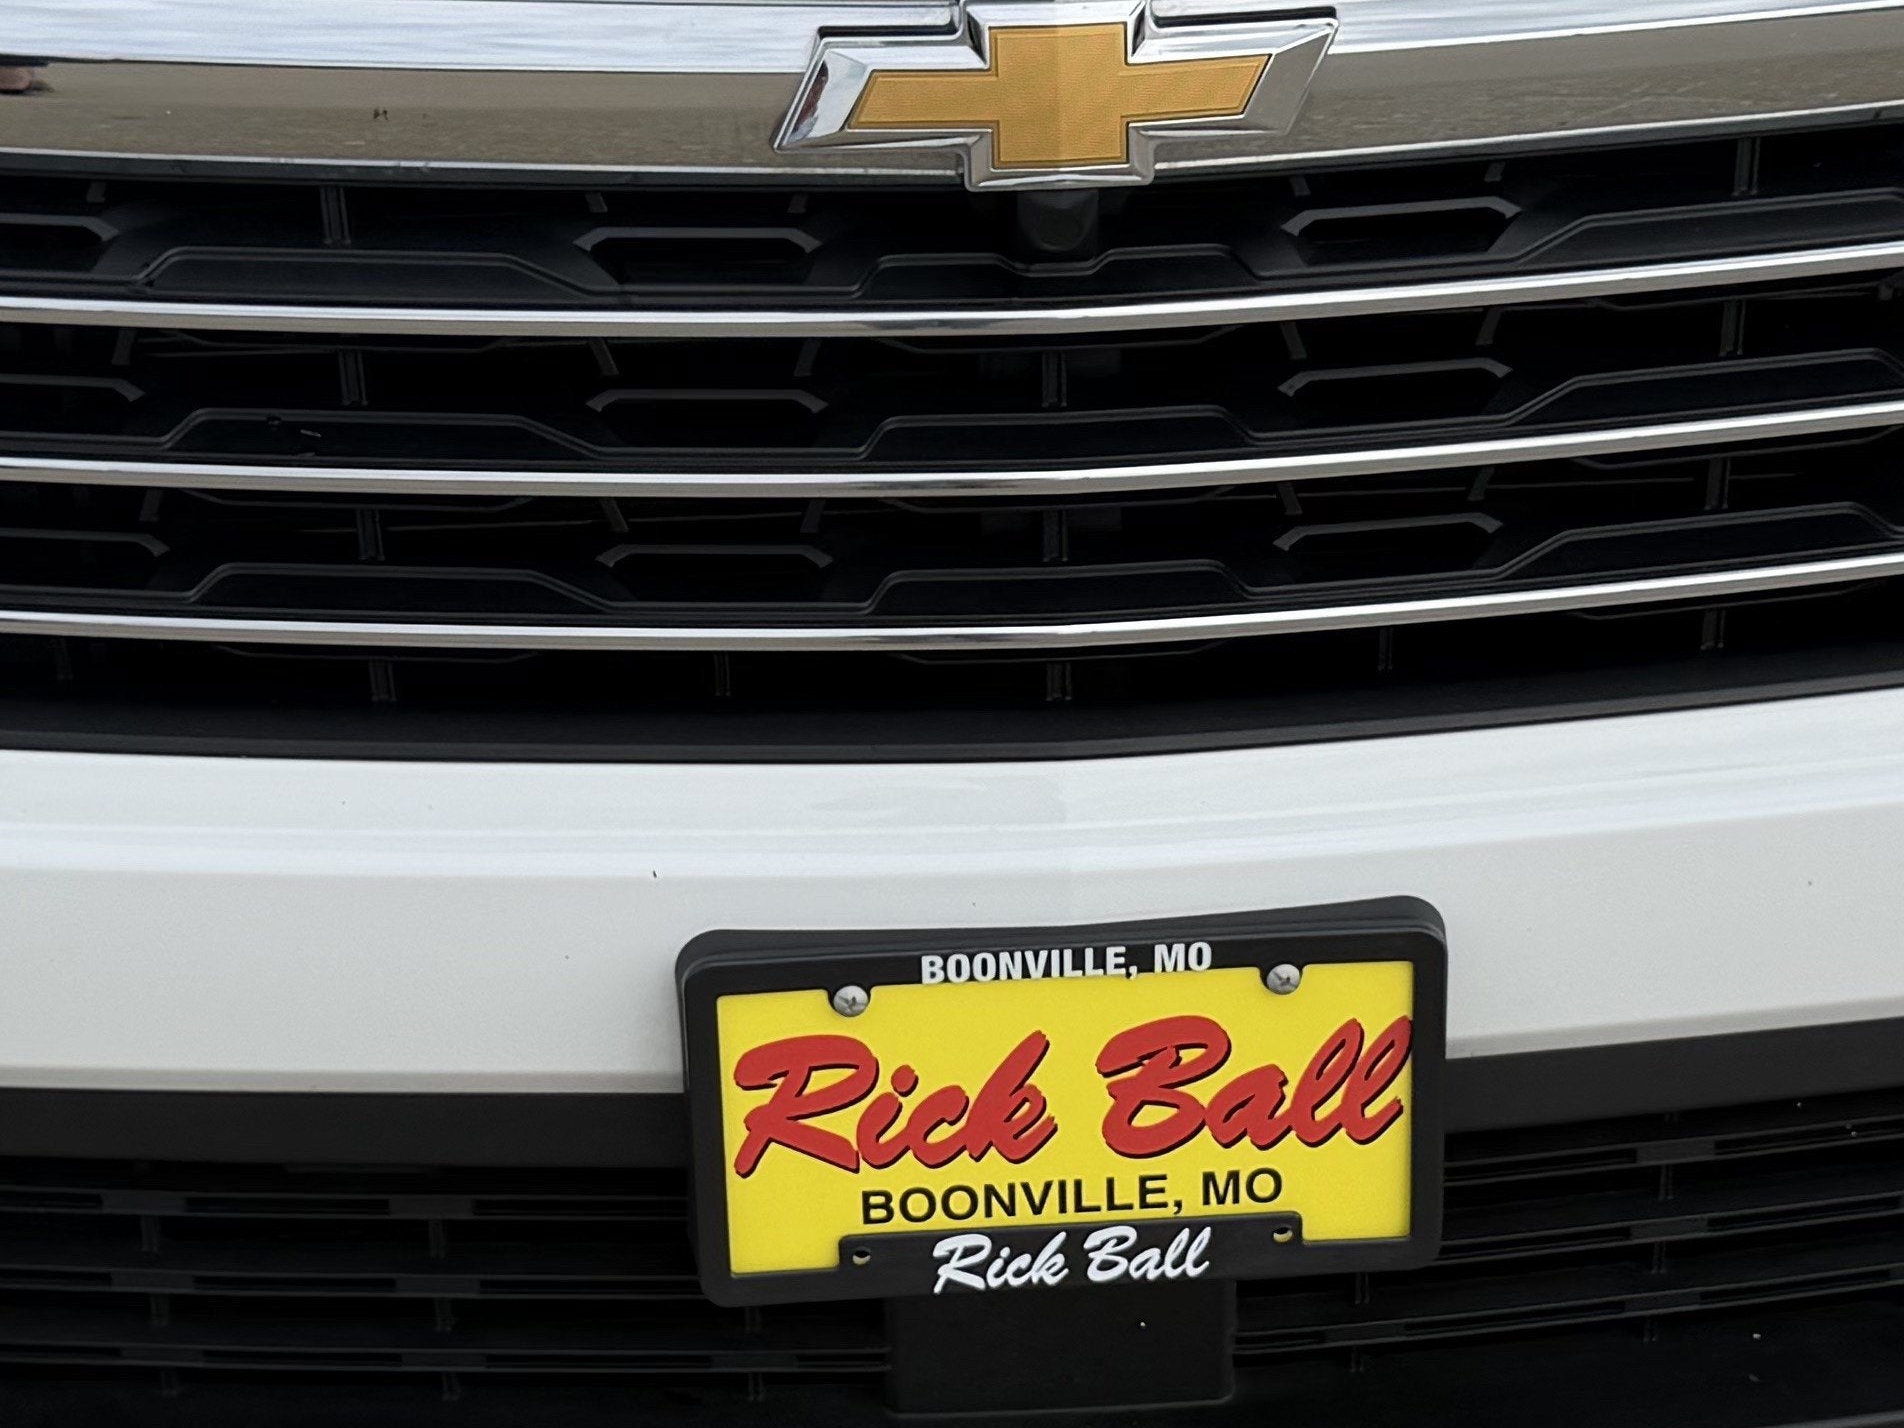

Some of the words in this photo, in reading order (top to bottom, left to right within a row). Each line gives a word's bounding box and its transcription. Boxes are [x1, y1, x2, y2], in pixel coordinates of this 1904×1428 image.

[921, 944, 1138, 985] BOONVILLE,
[1154, 941, 1213, 973] MO
[734, 1029, 1059, 1180] Rick
[1096, 1013, 1415, 1161] Ball
[861, 1173, 1183, 1225] BOONVILLE,
[1201, 1168, 1284, 1207] MO
[933, 1233, 1069, 1295] Rick
[1087, 1227, 1213, 1282] Ball
